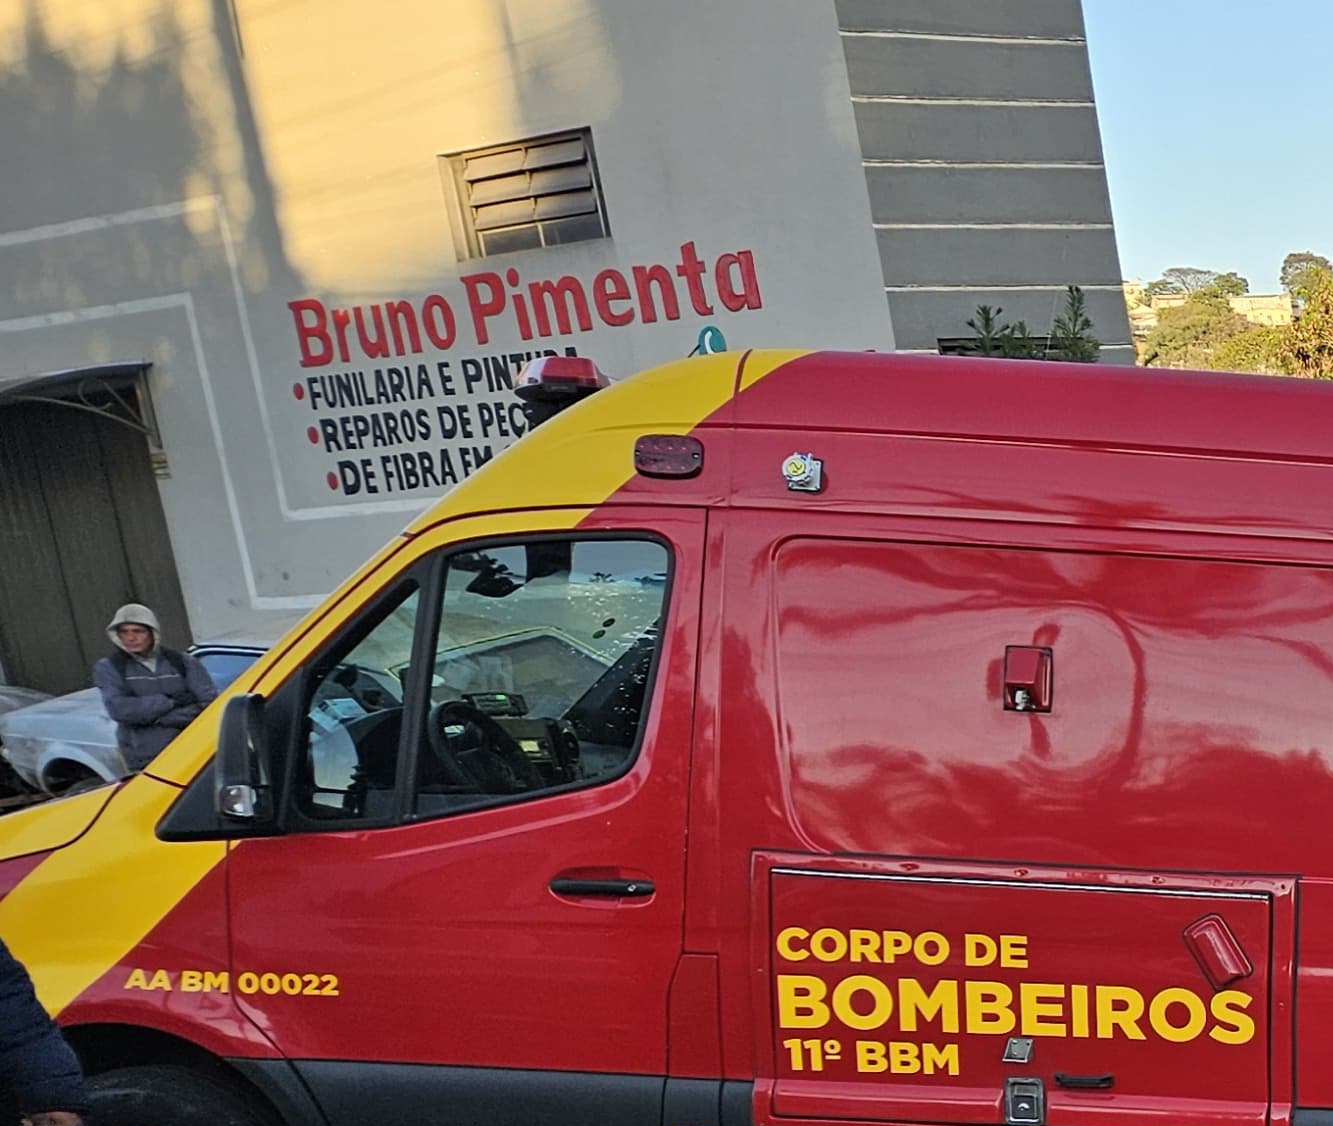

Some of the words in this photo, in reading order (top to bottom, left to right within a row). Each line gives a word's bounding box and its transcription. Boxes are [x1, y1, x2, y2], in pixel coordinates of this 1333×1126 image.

[289, 294, 456, 367] Bruno
[460, 241, 762, 345] Pimenta
[307, 364, 435, 411] FUNILARIA
[438, 361, 456, 396] E
[461, 347, 579, 395] PINT
[319, 408, 432, 453] REPAROS
[436, 403, 474, 439] DE
[337, 458, 379, 496] DE
[381, 448, 458, 492] FIBRA
[776, 927, 950, 966] CORPO
[965, 933, 1028, 968] DE
[124, 968, 172, 991] AA
[181, 970, 230, 993] BM
[238, 972, 340, 997] 00022
[776, 974, 1255, 1044] BOMBEIROS
[783, 1038, 841, 1071] 11º
[856, 1040, 960, 1076] BBM
